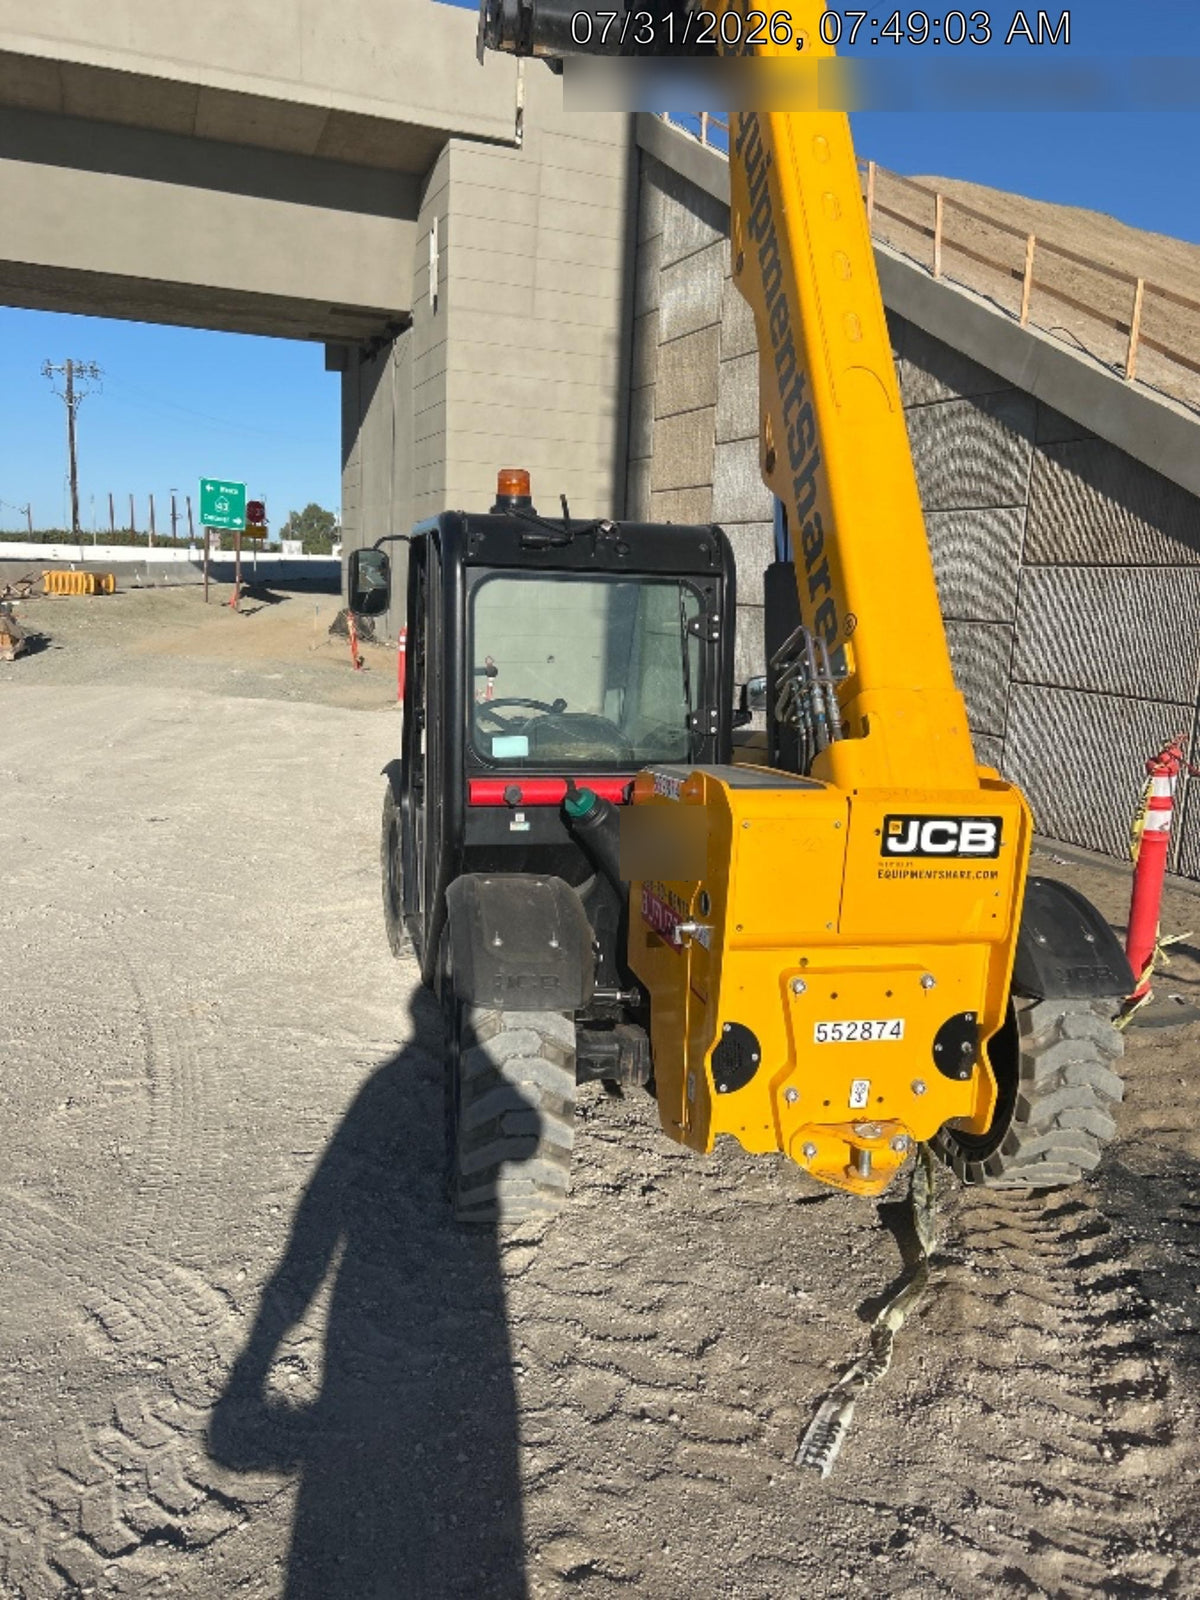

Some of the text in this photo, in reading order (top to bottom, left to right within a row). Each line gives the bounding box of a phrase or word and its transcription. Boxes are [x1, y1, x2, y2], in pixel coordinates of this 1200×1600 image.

[886, 820, 997, 853] JCB
[877, 868, 999, 881] EQUIPMENTSHARE.COM
[815, 1020, 902, 1042] 552874
